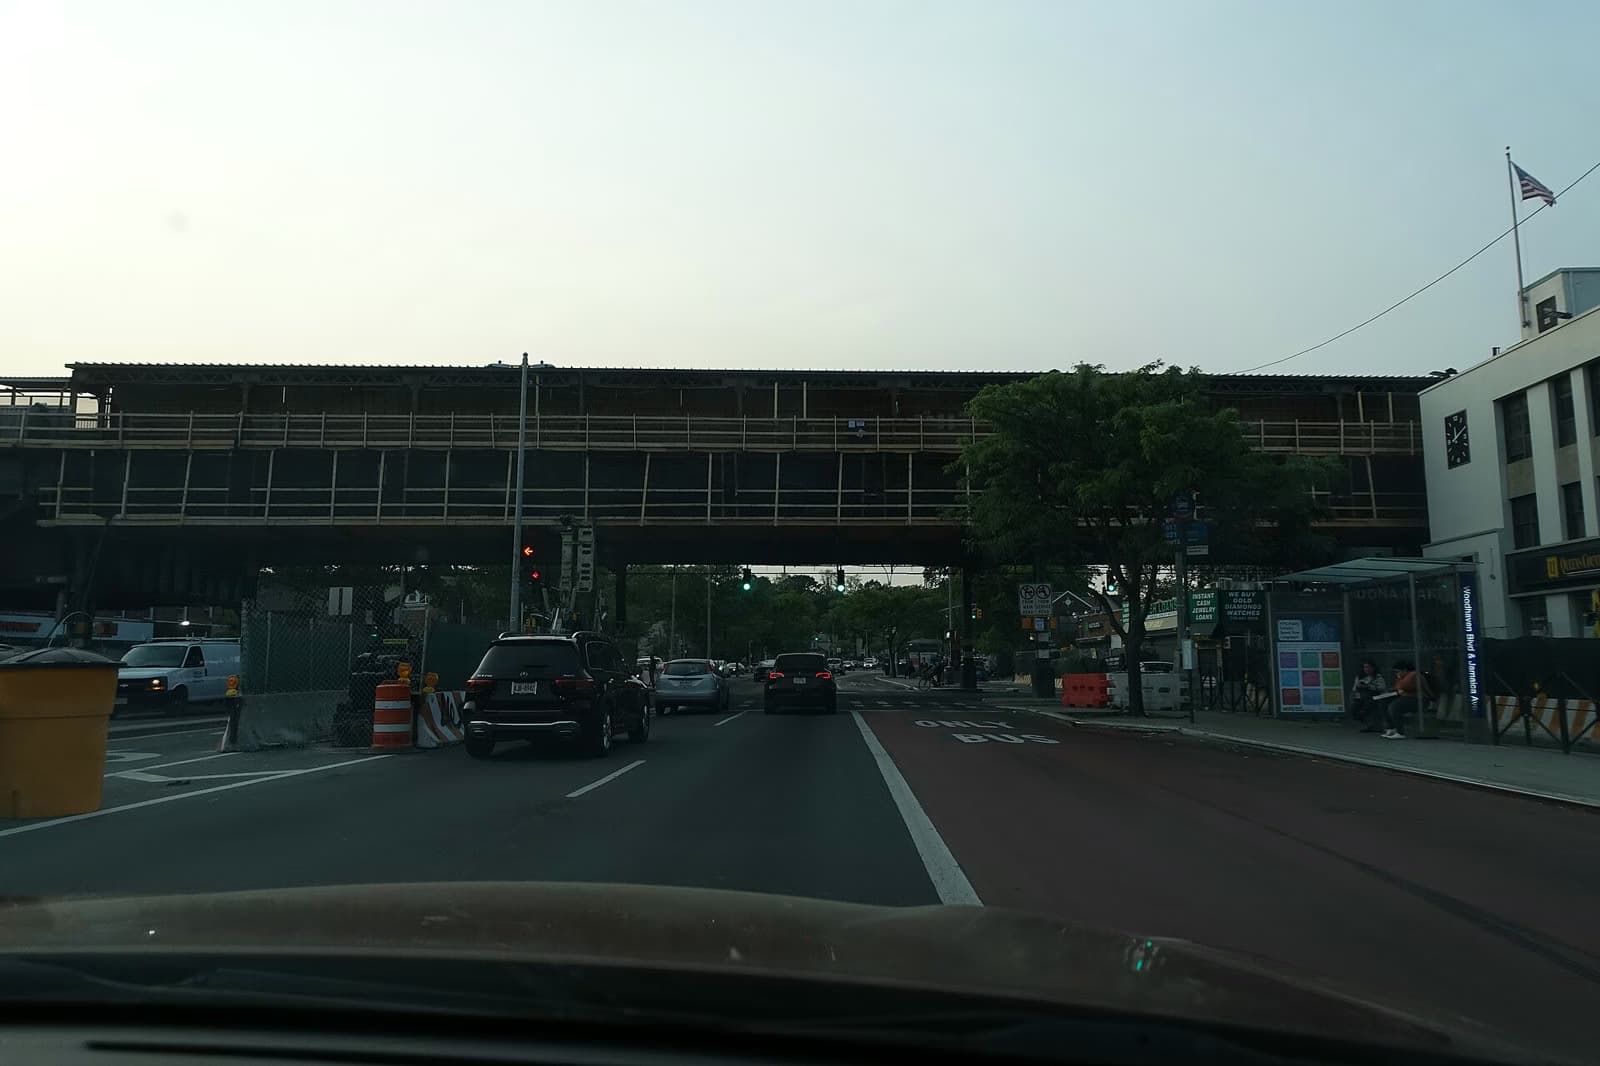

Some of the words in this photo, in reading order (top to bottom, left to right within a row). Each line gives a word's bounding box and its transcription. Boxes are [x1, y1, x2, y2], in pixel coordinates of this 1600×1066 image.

[1192, 592, 1215, 600] INSTANT
[1196, 599, 1211, 607] CASH
[1224, 603, 1262, 611] DIAMONDS
[1191, 606, 1216, 614] JEWELRY
[1226, 609, 1261, 617] WATCHES
[1195, 613, 1213, 621] LOANS
[1466, 633, 1476, 651] Blvd
[1468, 660, 1478, 694] Jamaica
[914, 720, 1016, 729] ONLY
[951, 733, 1061, 744] BUS
